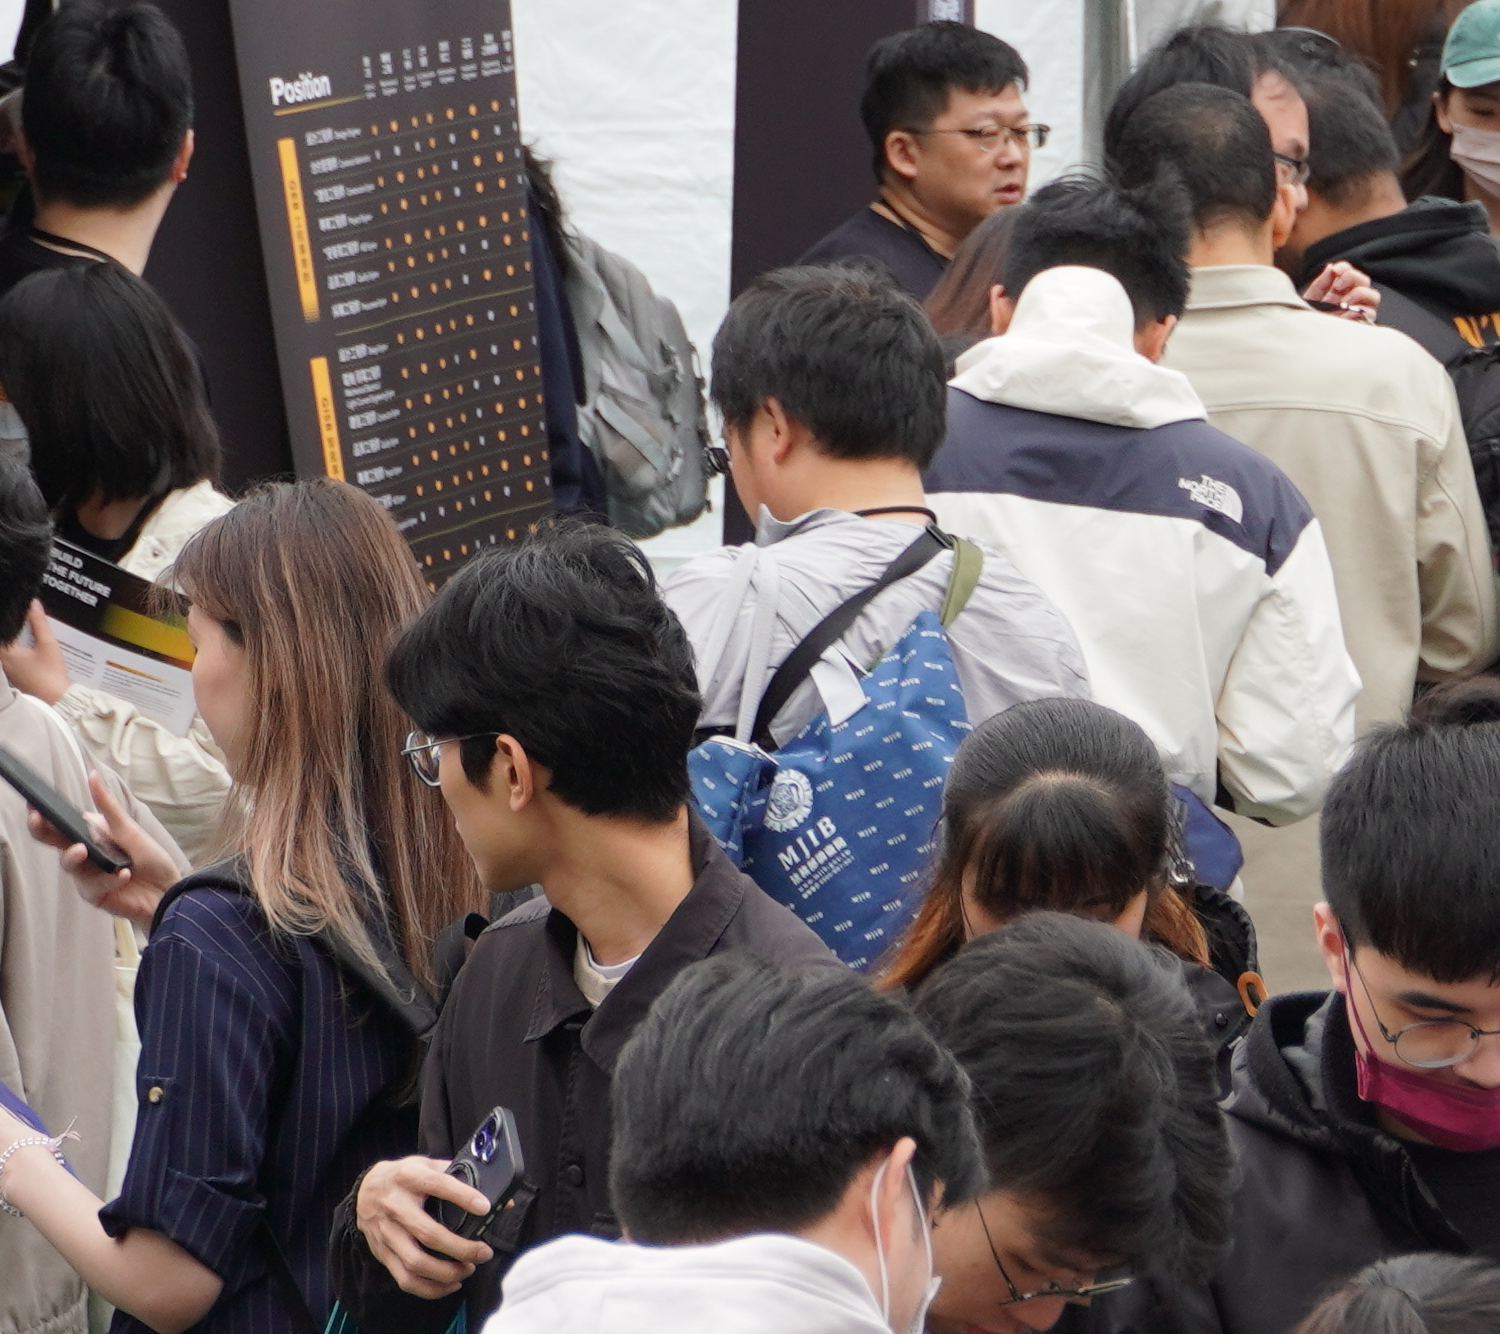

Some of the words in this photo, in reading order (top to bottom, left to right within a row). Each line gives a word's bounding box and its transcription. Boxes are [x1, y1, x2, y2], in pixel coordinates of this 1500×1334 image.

[269, 72, 332, 106] Position
[42, 573, 99, 608] TOGETHER
[68, 569, 112, 599] FUTURE
[777, 816, 837, 872] MJIB
